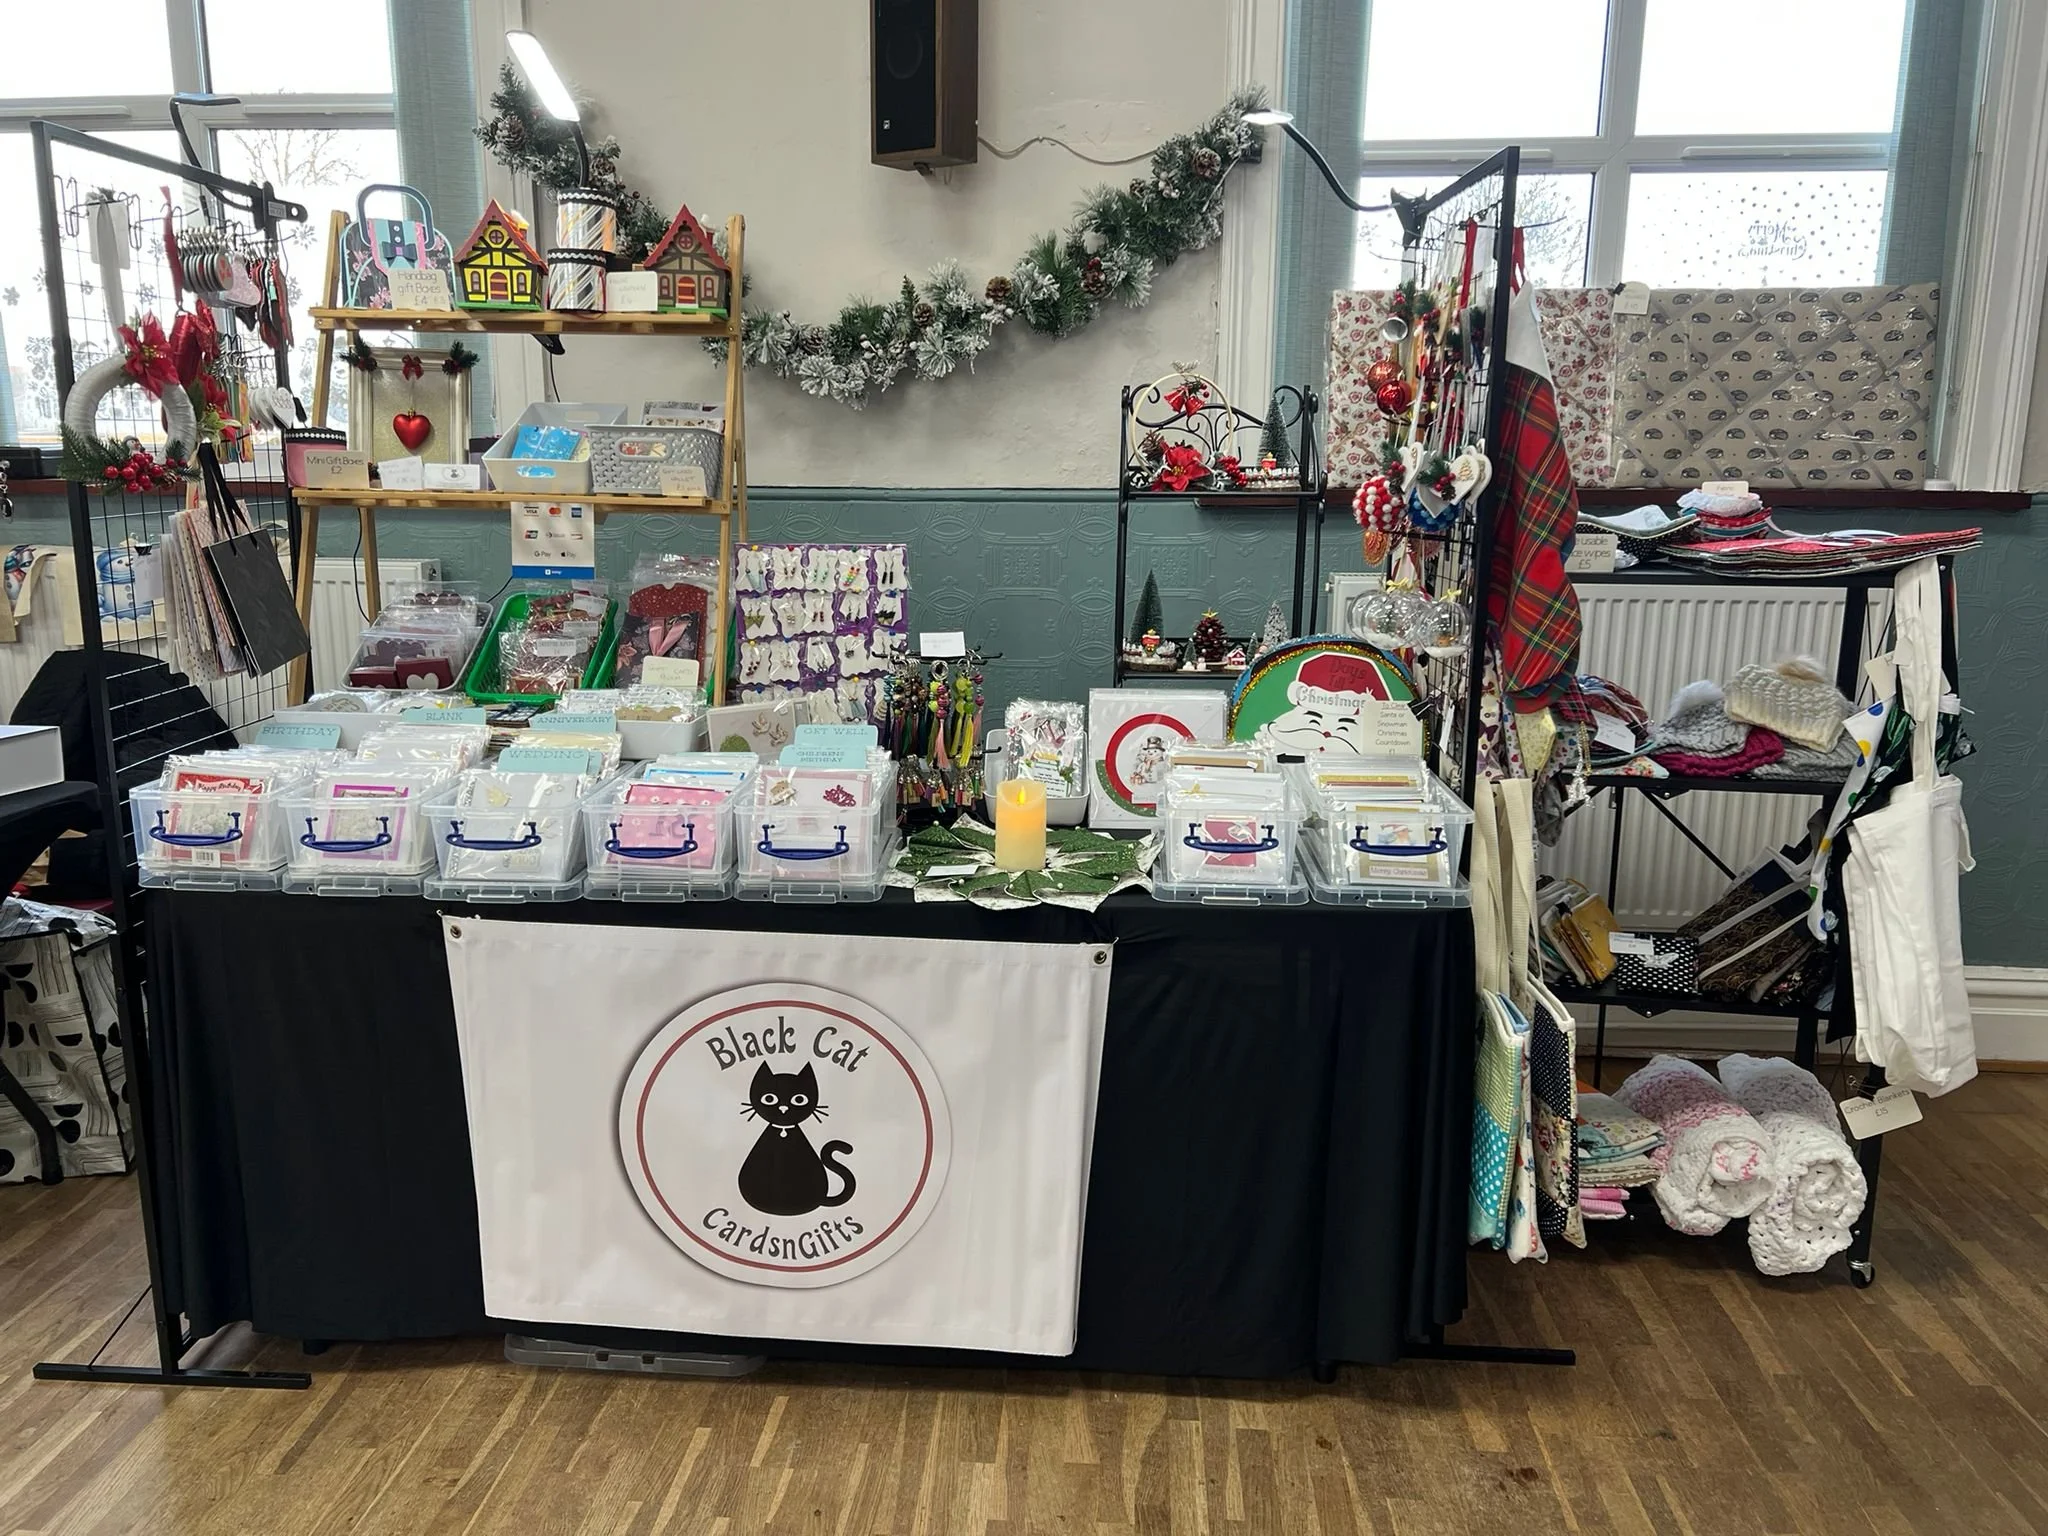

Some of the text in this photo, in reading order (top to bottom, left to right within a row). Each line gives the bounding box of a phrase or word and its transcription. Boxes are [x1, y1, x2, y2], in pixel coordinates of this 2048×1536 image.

[397, 270, 437, 284] Handbag
[397, 282, 441, 296] gift Boxes
[306, 456, 365, 465] Mini Gift Boxes
[331, 465, 343, 474] £2
[1583, 550, 1611, 560] wipes
[1578, 559, 1592, 570] £5
[1381, 702, 1390, 710] To
[426, 712, 463, 721] BLANK
[1380, 711, 1397, 719] Santa
[537, 716, 612, 724] ANNIVERSARY
[1377, 720, 1408, 728] Snowman
[262, 726, 337, 736] BIRTHDAY
[803, 727, 868, 735] GET WELL
[1377, 729, 1408, 737] Christmas
[509, 750, 585, 759] WEDDING
[705, 1016, 870, 1073] Black Cat
[1876, 1089, 1910, 1105] Blankets
[1875, 1106, 1889, 1117] £15
[702, 1207, 864, 1260] CardsnGifts
